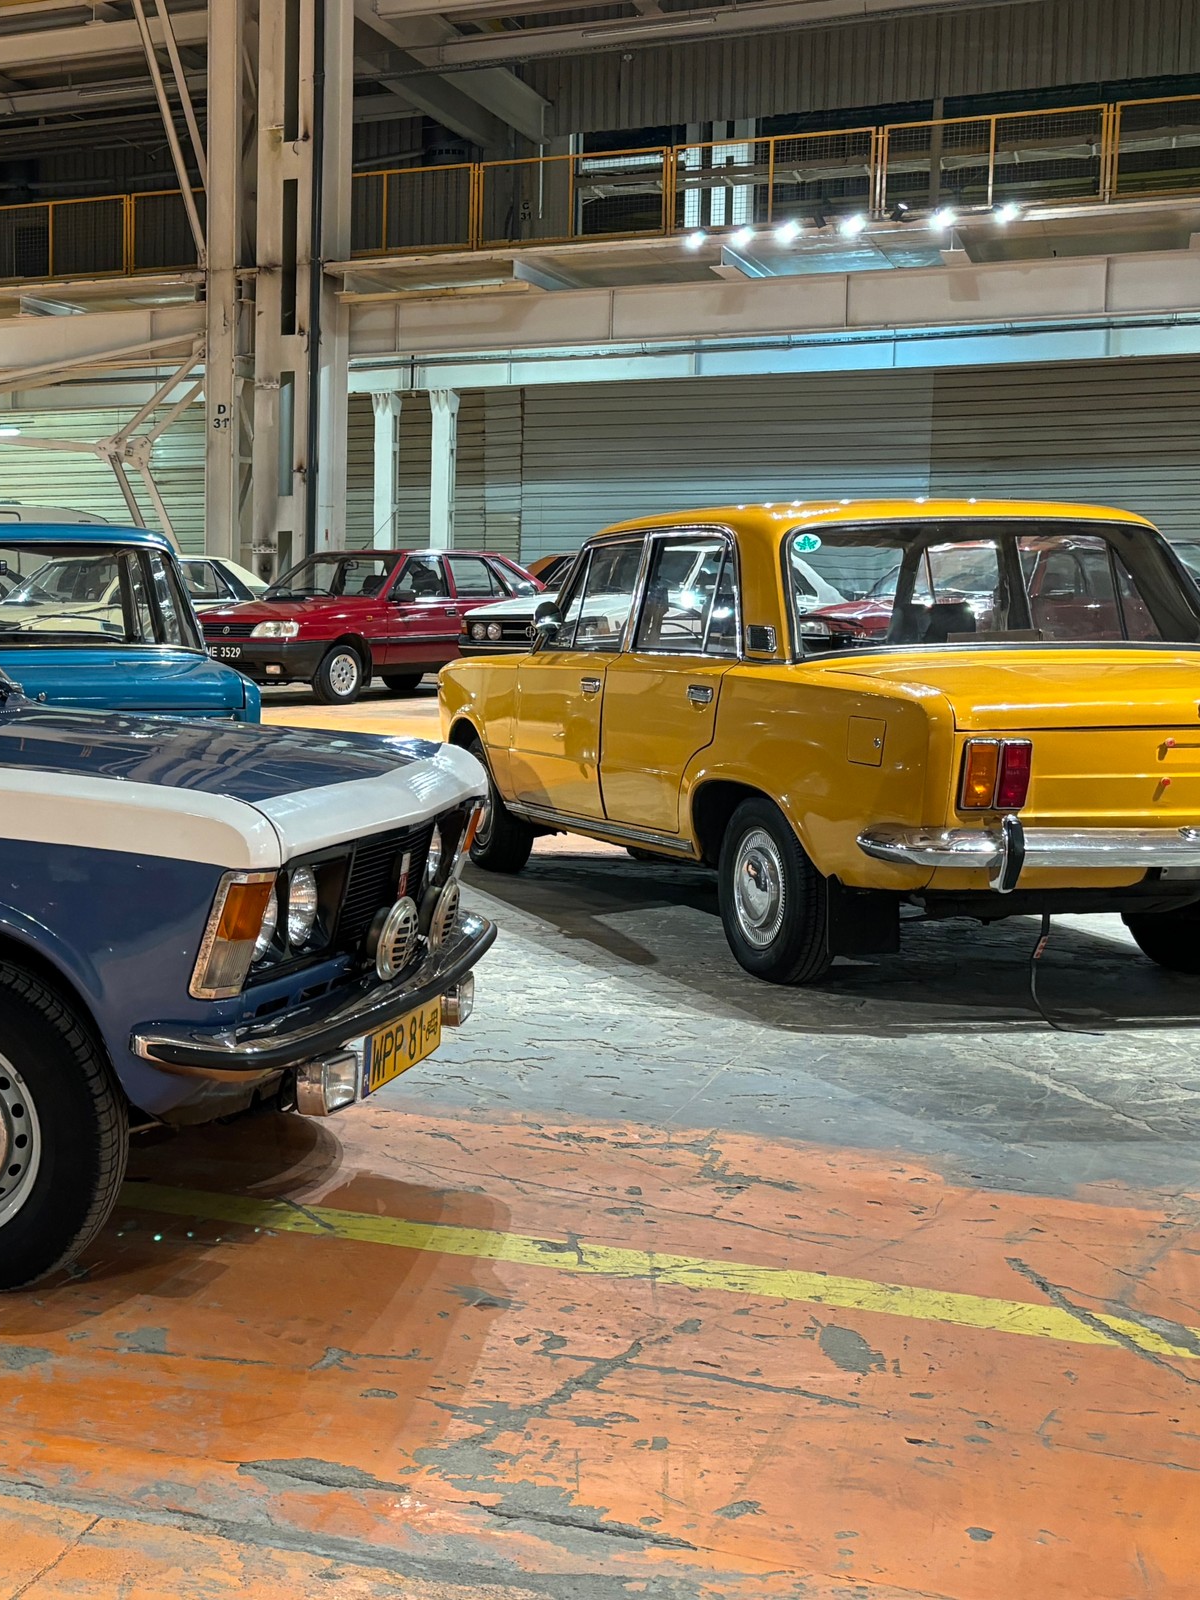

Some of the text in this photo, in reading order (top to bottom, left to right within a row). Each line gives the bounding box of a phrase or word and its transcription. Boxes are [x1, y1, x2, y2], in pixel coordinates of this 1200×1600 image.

[217, 404, 227, 415] D
[213, 417, 228, 429] 31
[220, 646, 242, 658] 3529
[371, 1022, 405, 1087] WPP
